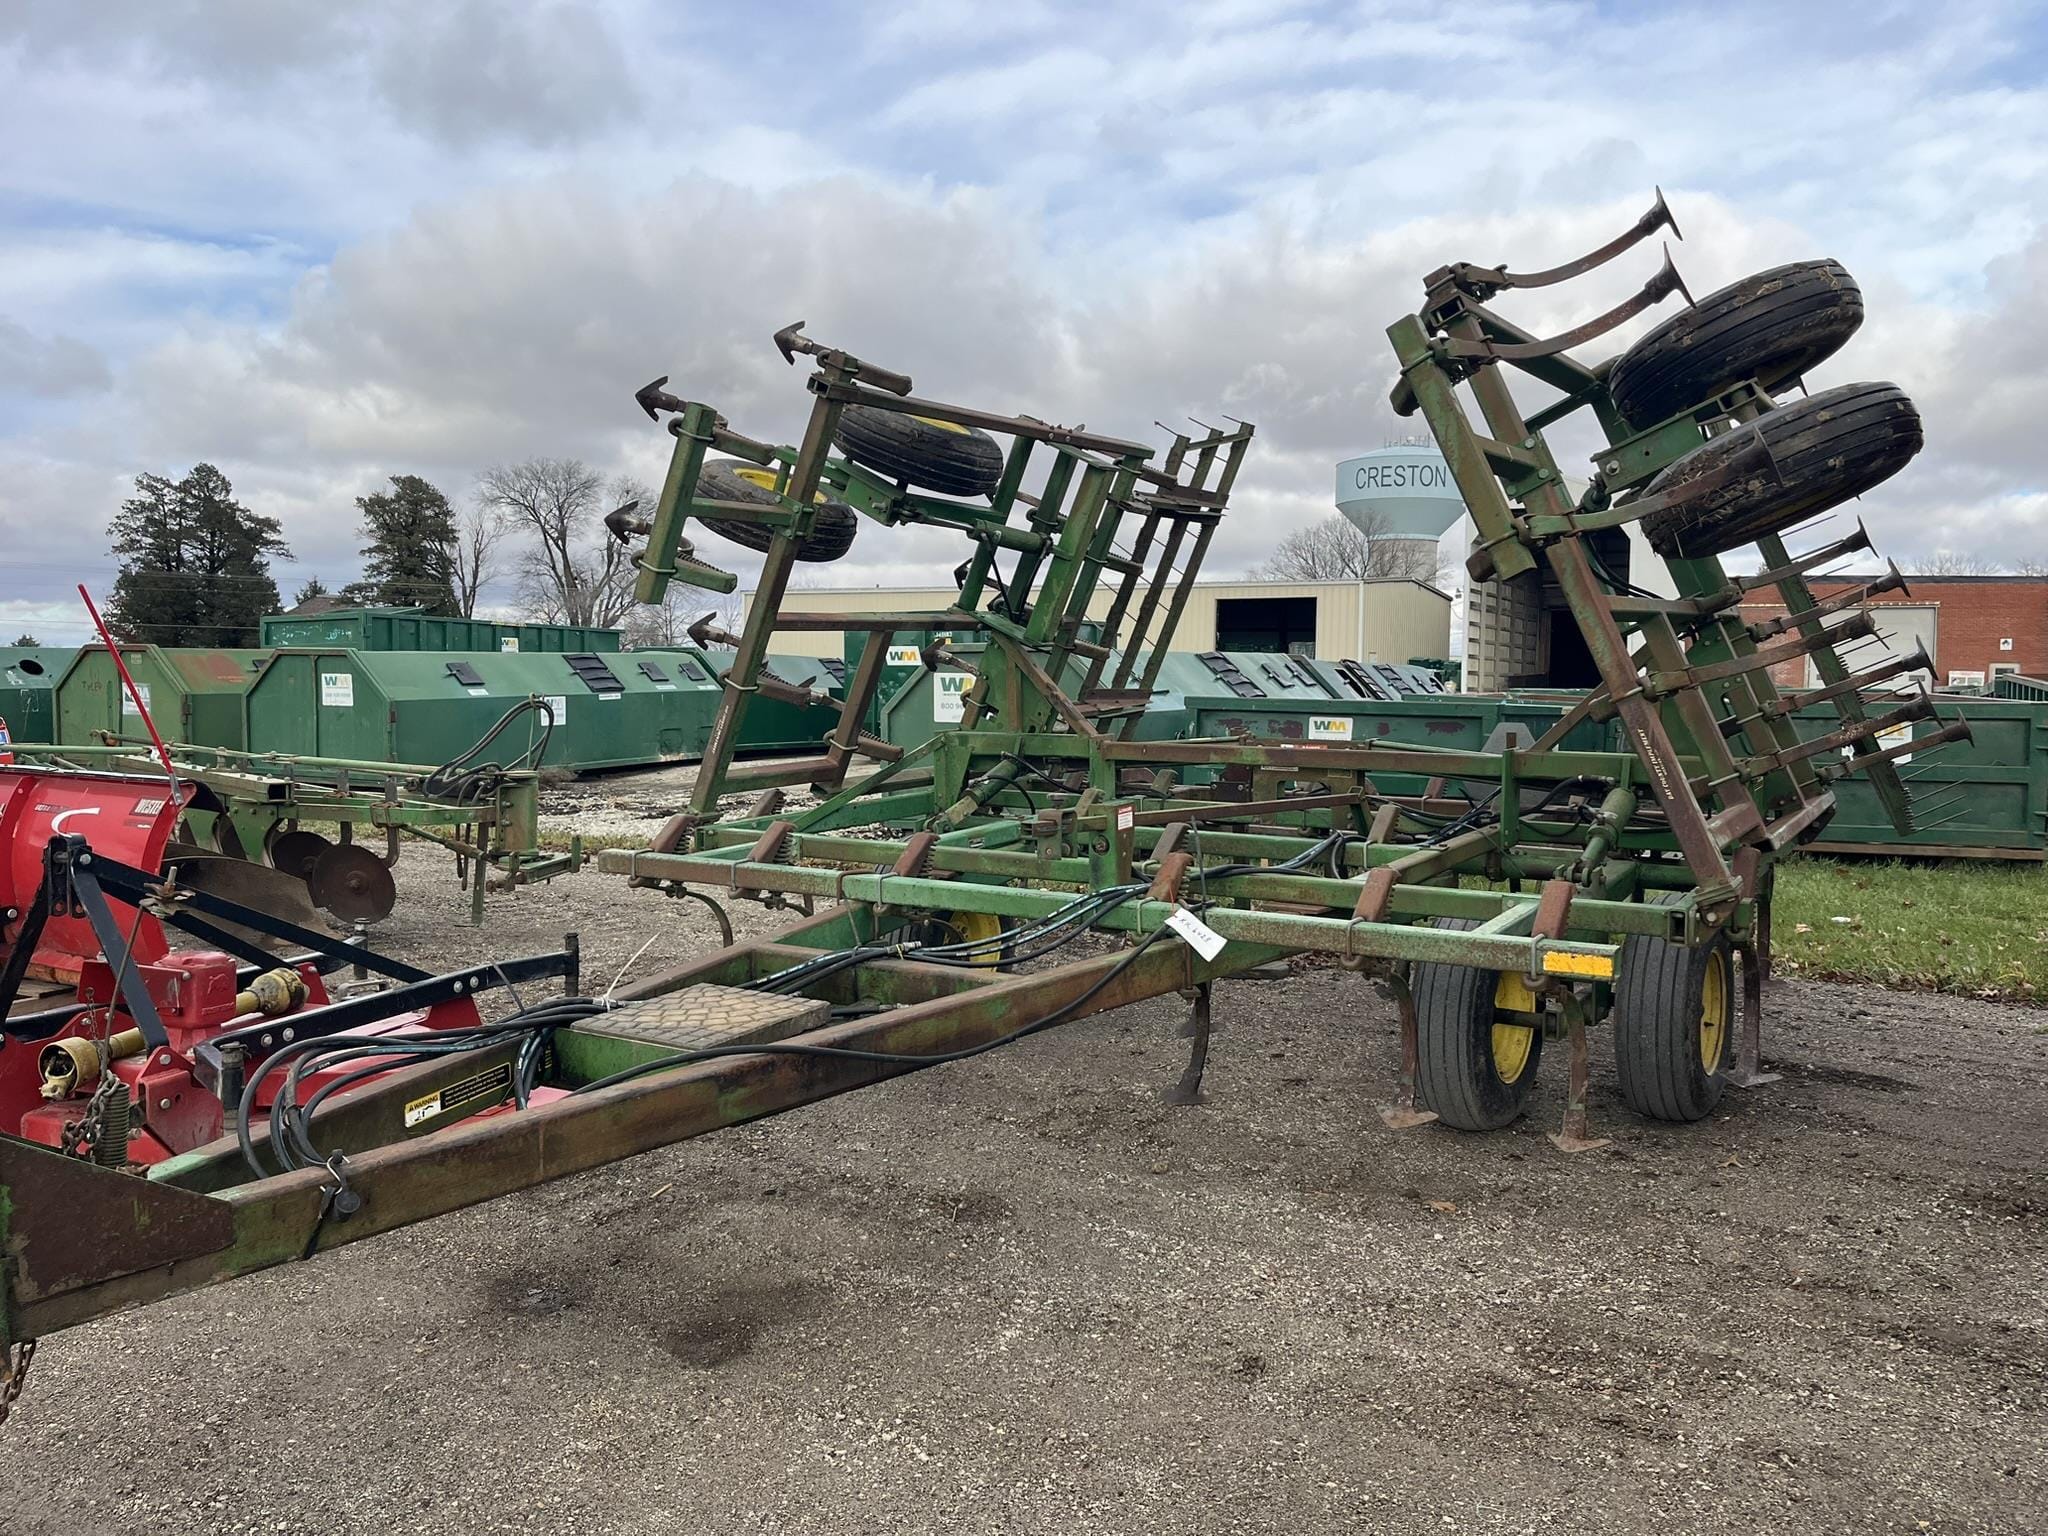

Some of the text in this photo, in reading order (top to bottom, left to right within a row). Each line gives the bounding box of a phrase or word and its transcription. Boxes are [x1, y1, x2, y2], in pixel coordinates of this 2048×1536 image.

[1356, 465, 1447, 490] CRESTON
[889, 651, 918, 661] WM
[1313, 720, 1347, 731] WM
[1637, 728, 1658, 764] IMPLEMENT
[414, 1094, 439, 1111] WARNING
